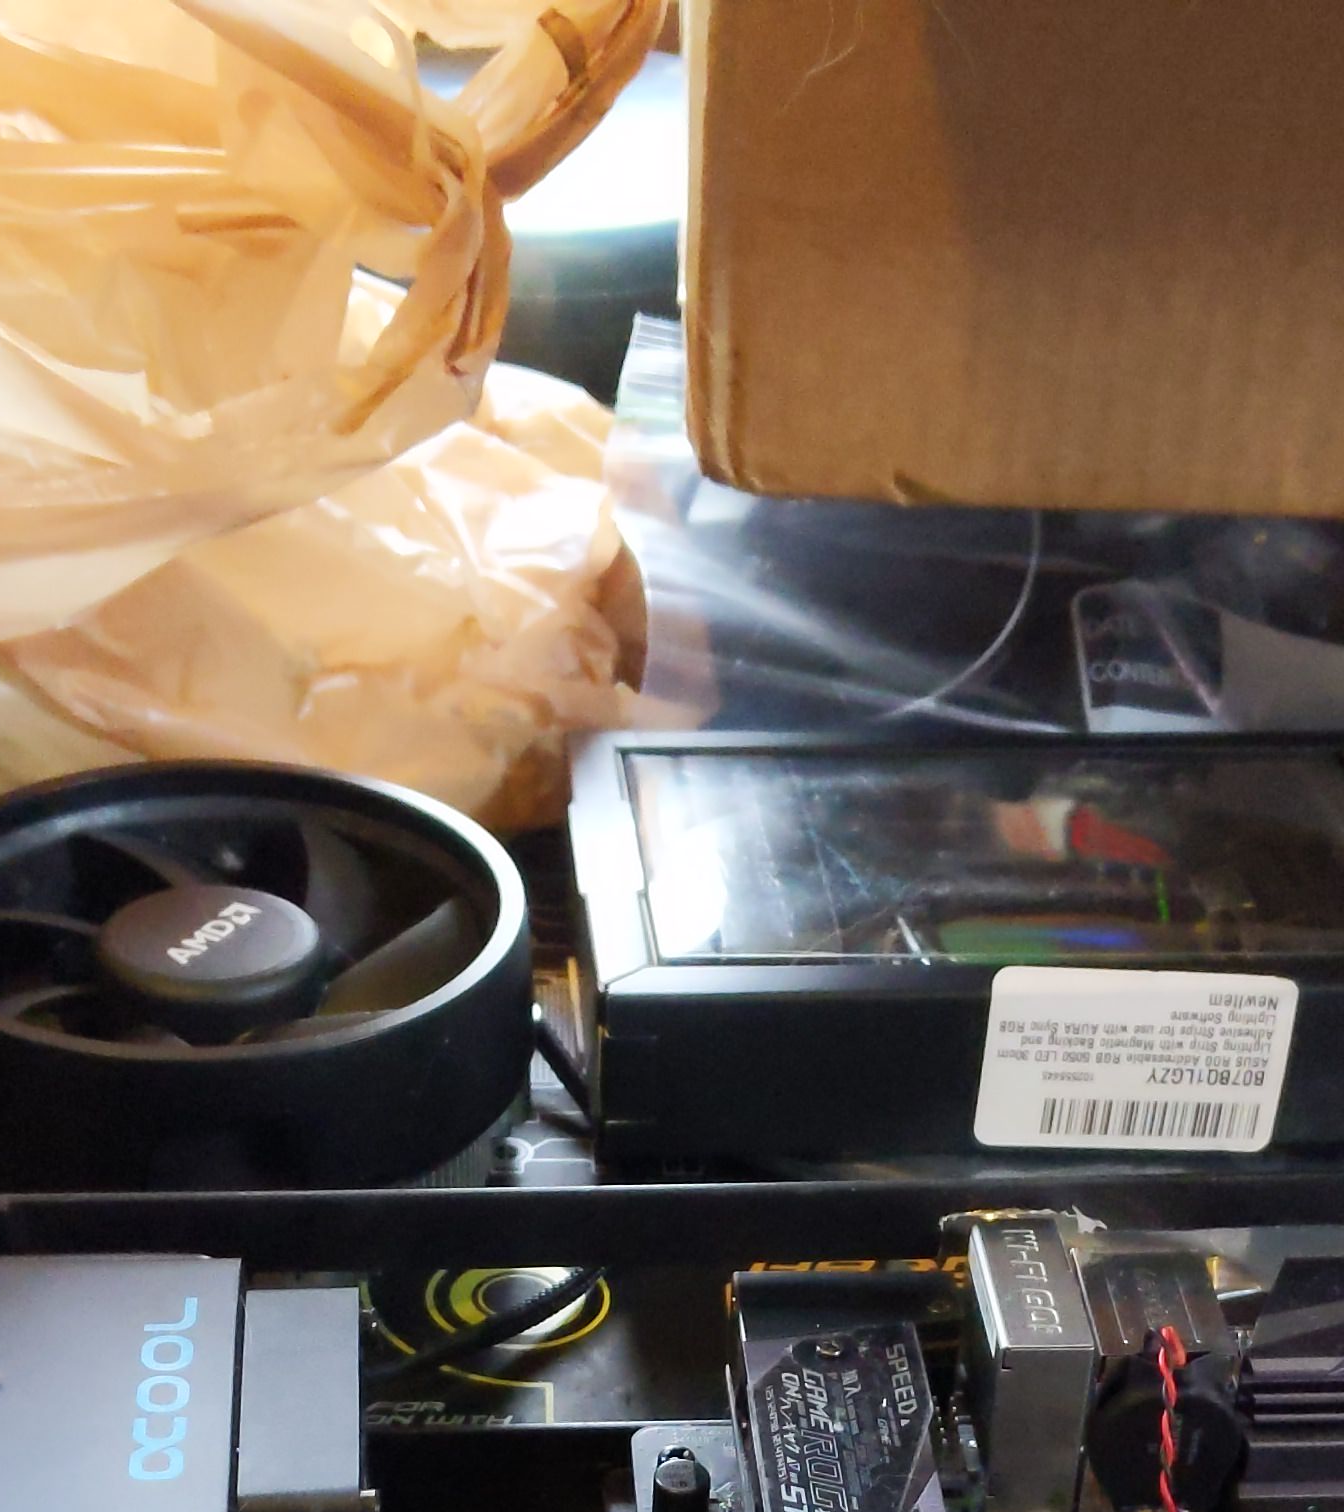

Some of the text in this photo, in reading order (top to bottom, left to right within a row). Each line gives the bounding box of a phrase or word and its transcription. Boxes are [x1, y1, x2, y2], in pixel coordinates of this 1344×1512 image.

[166, 918, 235, 966] AMD
[801, 1365, 834, 1435] GAME
[885, 1342, 917, 1416] SPEED
